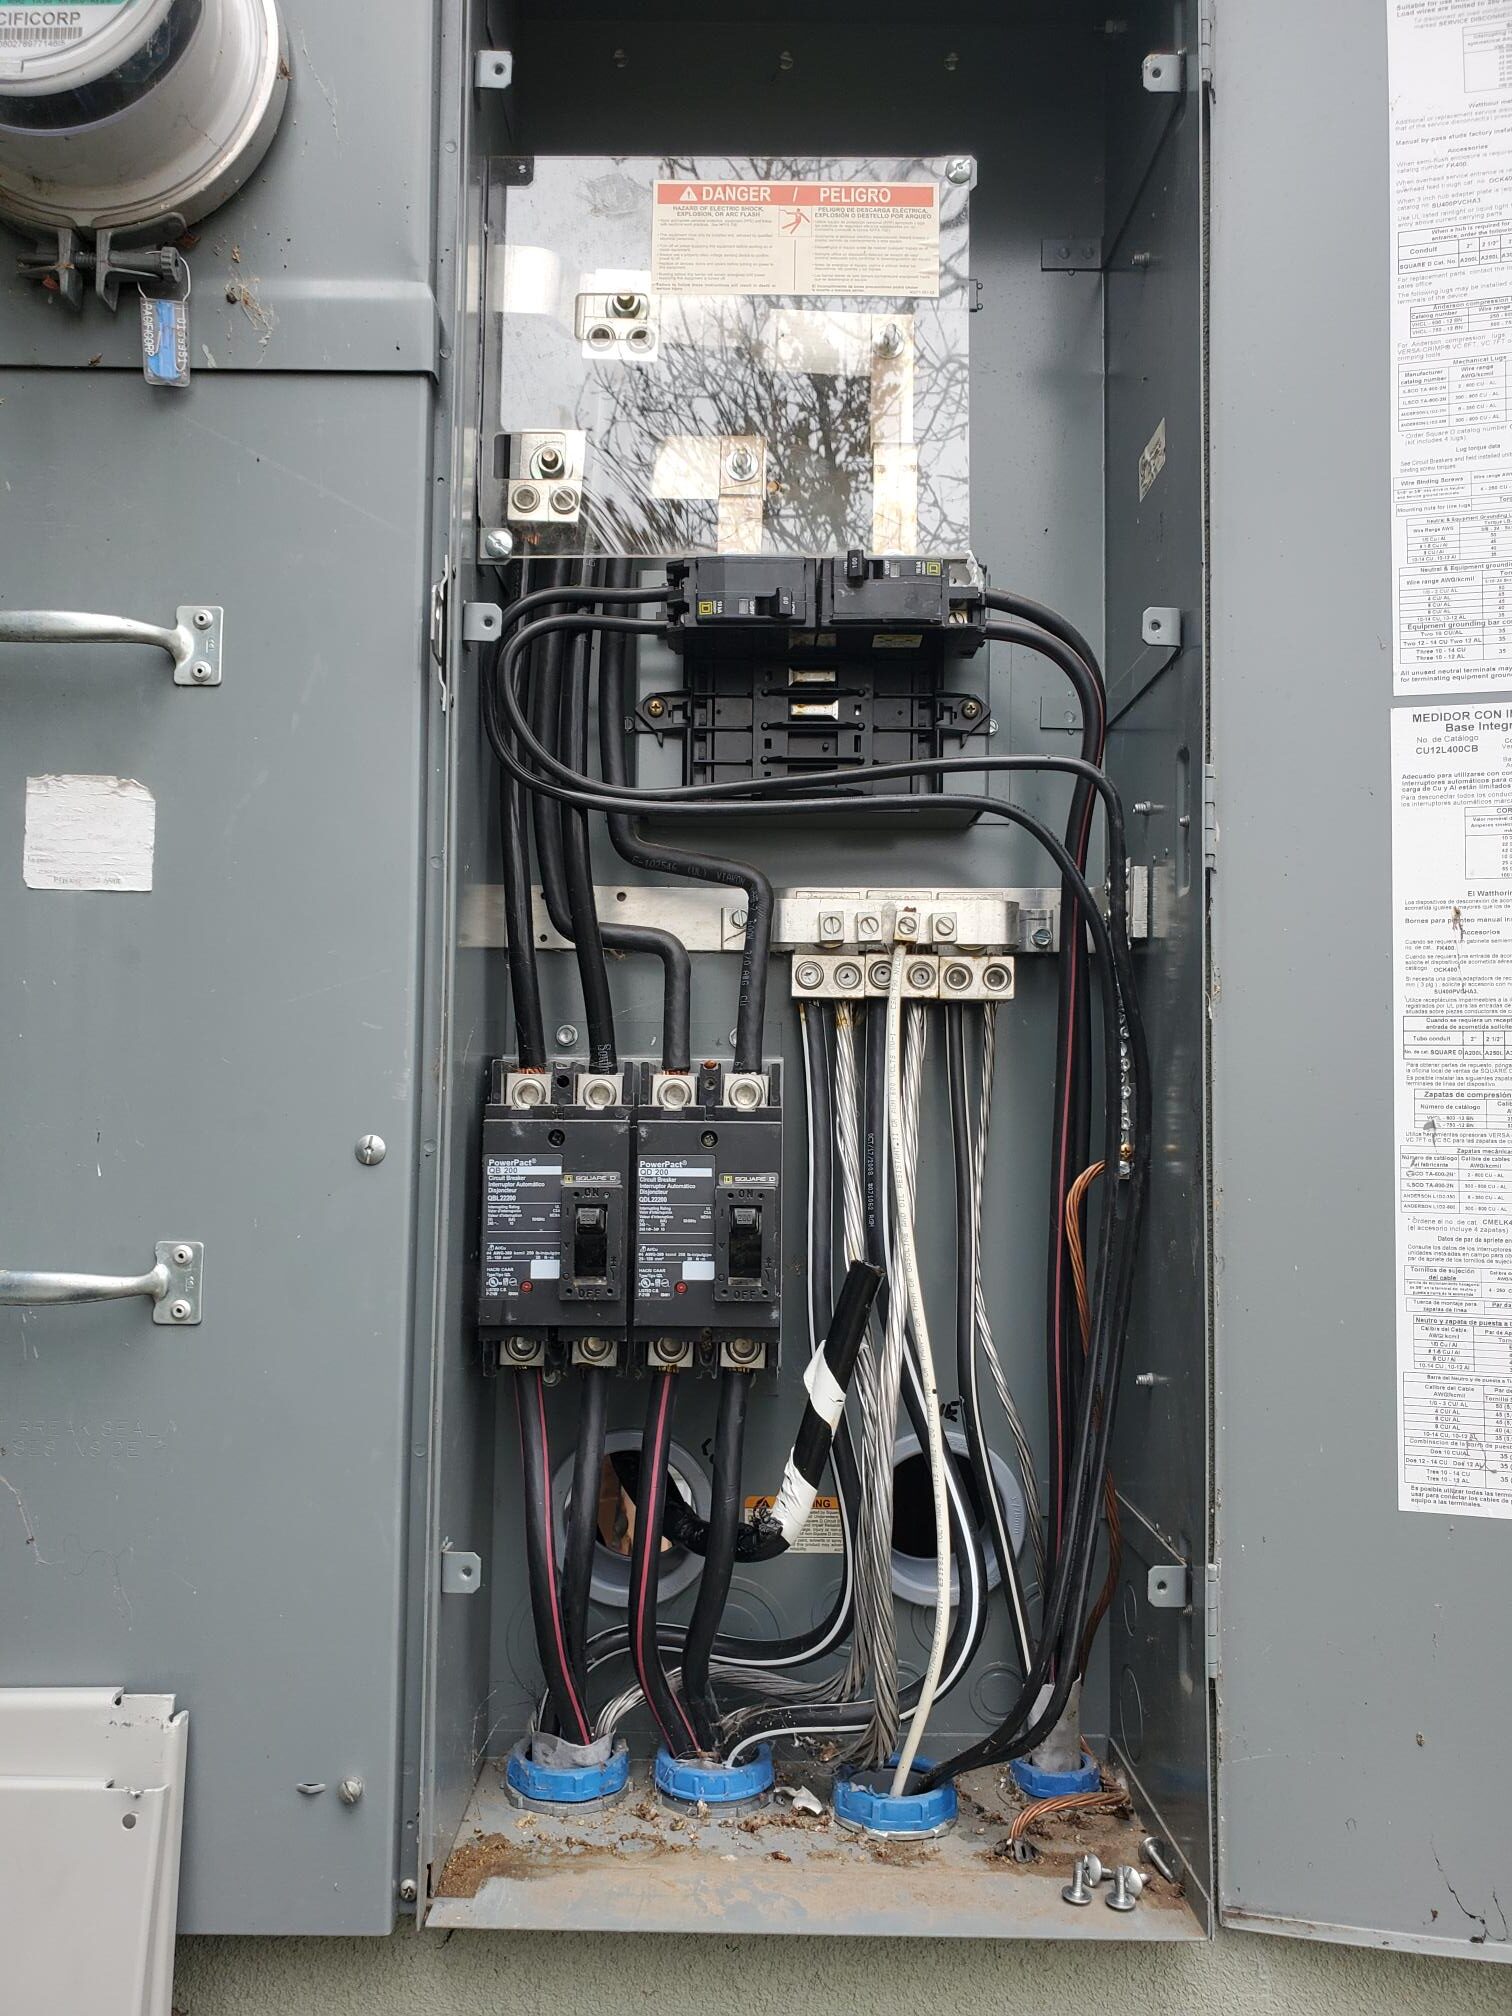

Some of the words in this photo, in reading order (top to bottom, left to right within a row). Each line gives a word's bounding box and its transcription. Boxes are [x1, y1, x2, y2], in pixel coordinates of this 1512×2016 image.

[702, 186, 771, 201] DANGER
[820, 187, 891, 203] PELIGRO
[1407, 622, 1445, 631] Equipment
[1448, 619, 1485, 629] grounding
[1412, 711, 1470, 723] MEDIDOR
[1474, 710, 1501, 719] CON
[1446, 724, 1474, 732] Base
[1416, 745, 1479, 755] CU12L400CB
[1424, 1091, 1453, 1099] Zapatas
